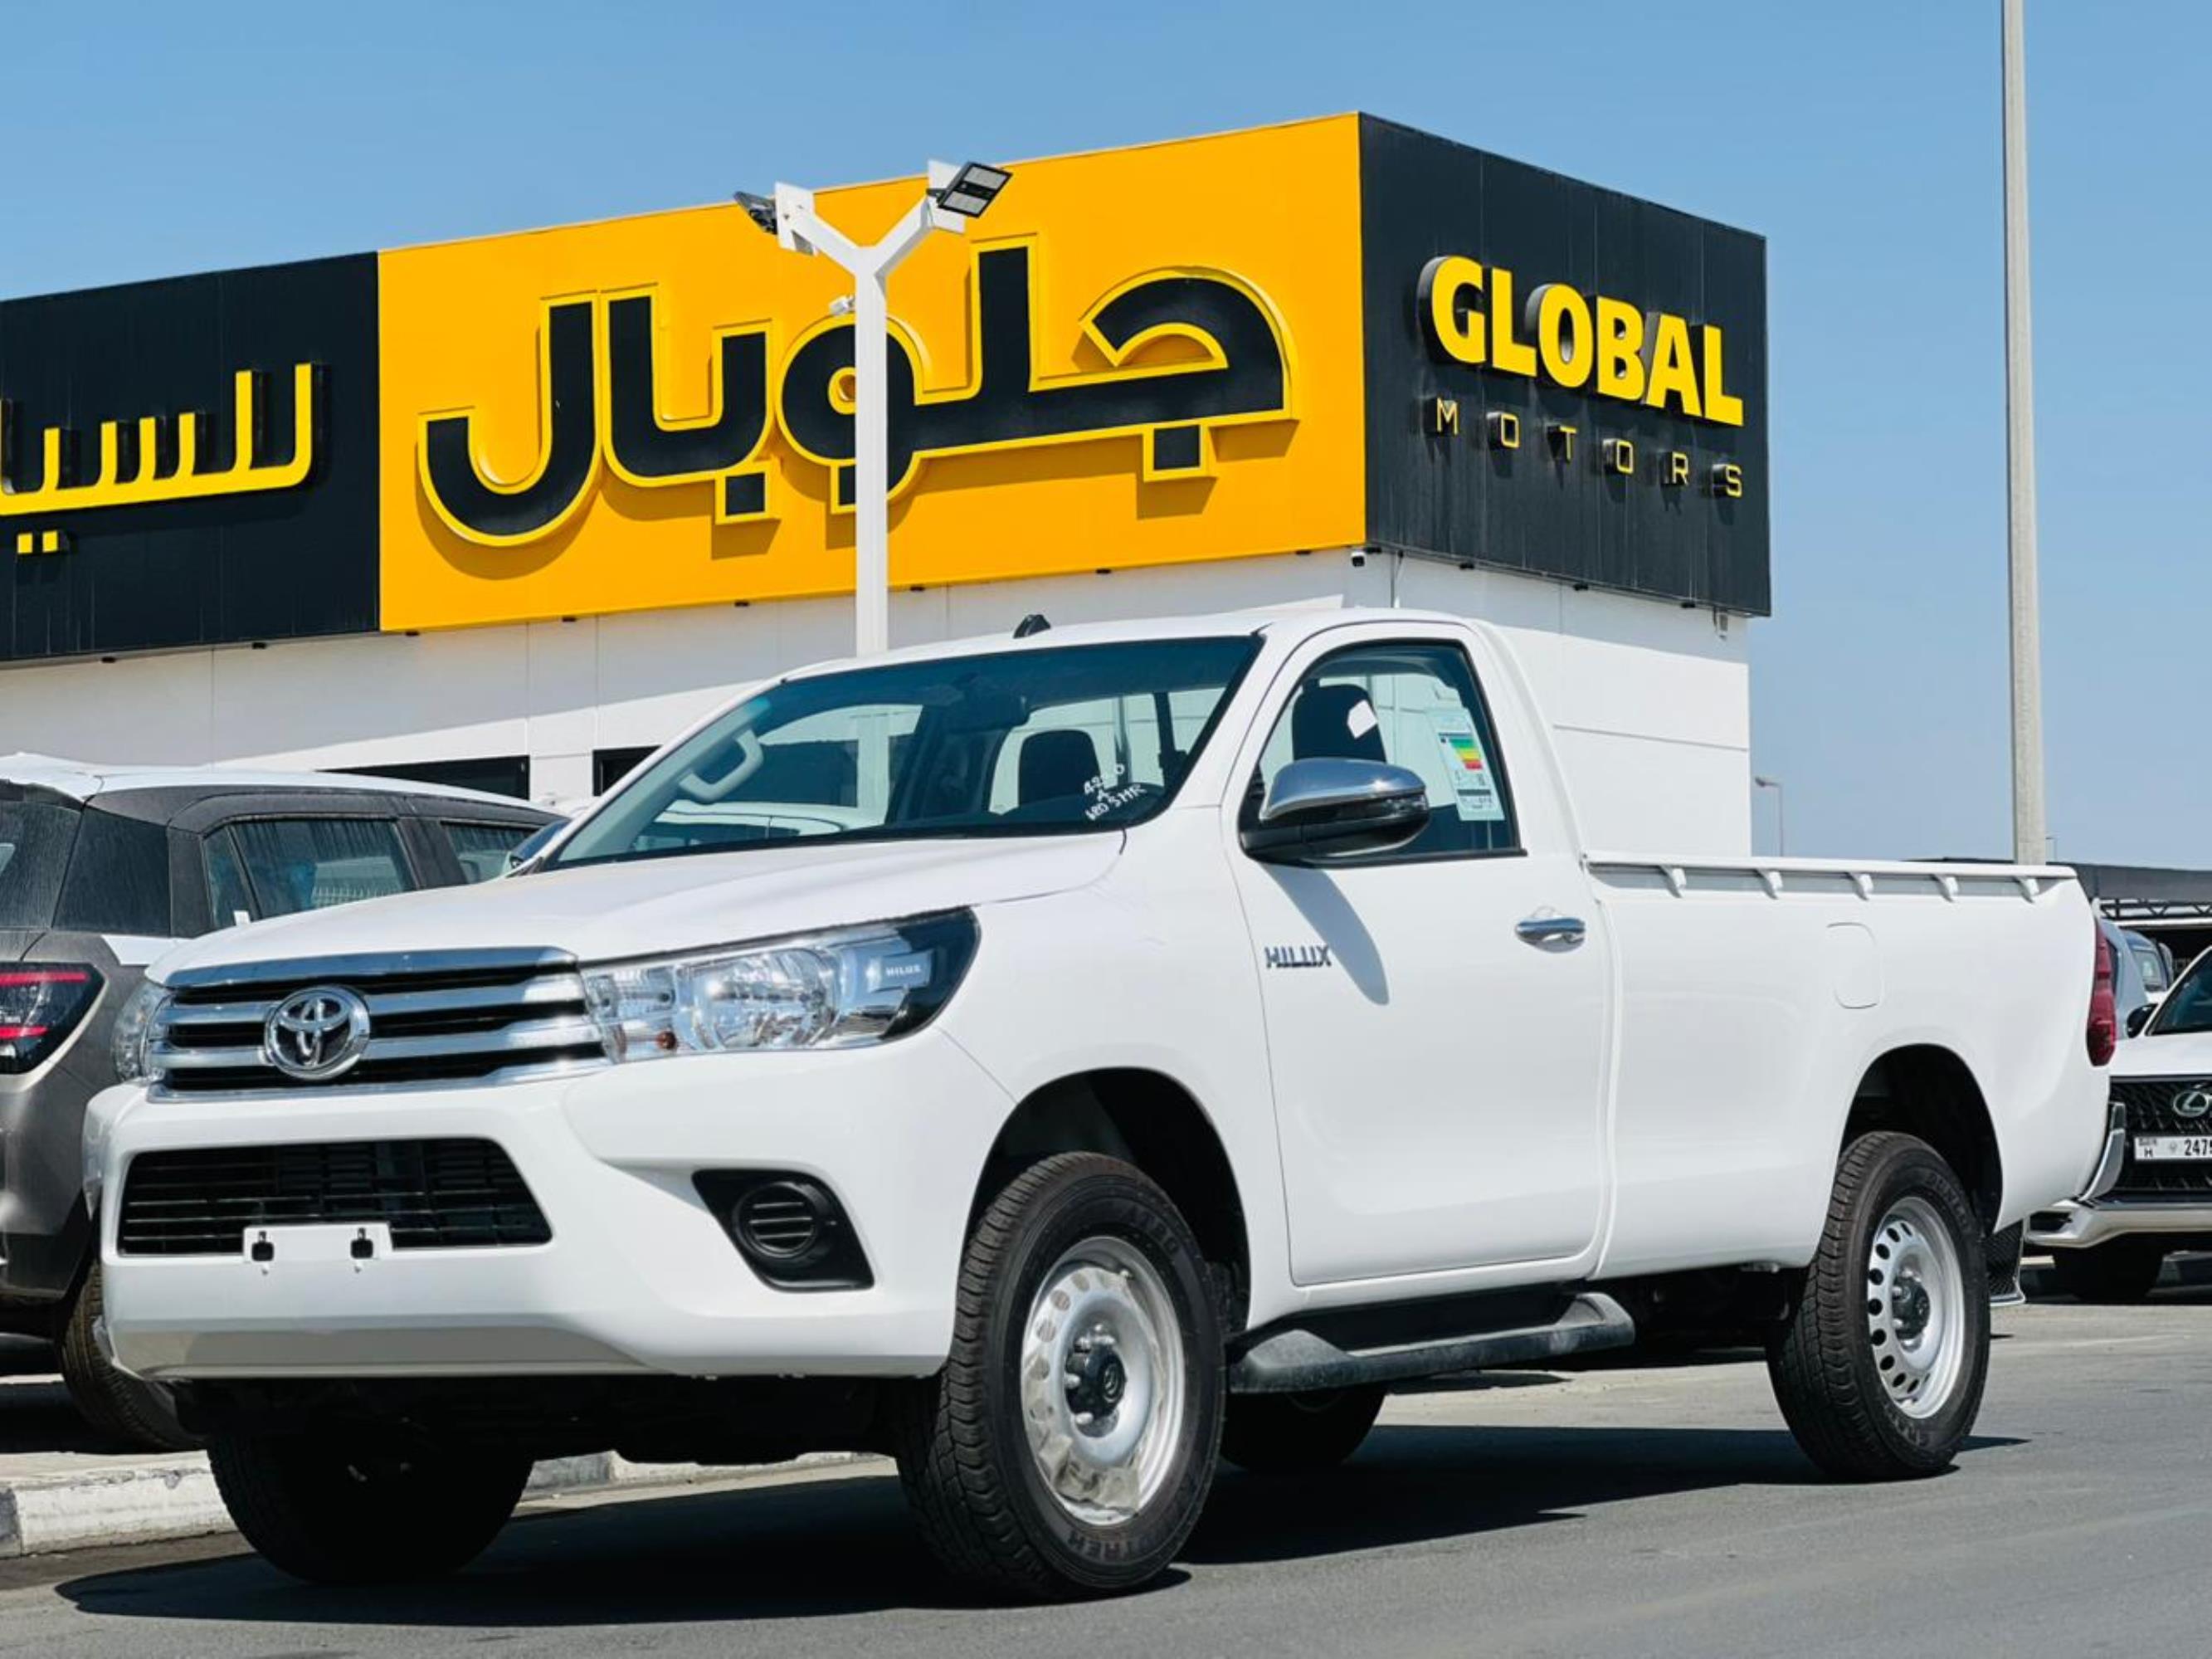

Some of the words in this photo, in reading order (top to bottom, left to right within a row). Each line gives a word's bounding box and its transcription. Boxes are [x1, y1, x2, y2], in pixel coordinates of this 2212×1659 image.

[1430, 255, 1743, 427] GLOBAL
[0, 363, 312, 554] للسي
[1436, 398, 1742, 498] MOTORS
[885, 964, 921, 976] HILUX
[1264, 945, 1332, 968] HILUX
